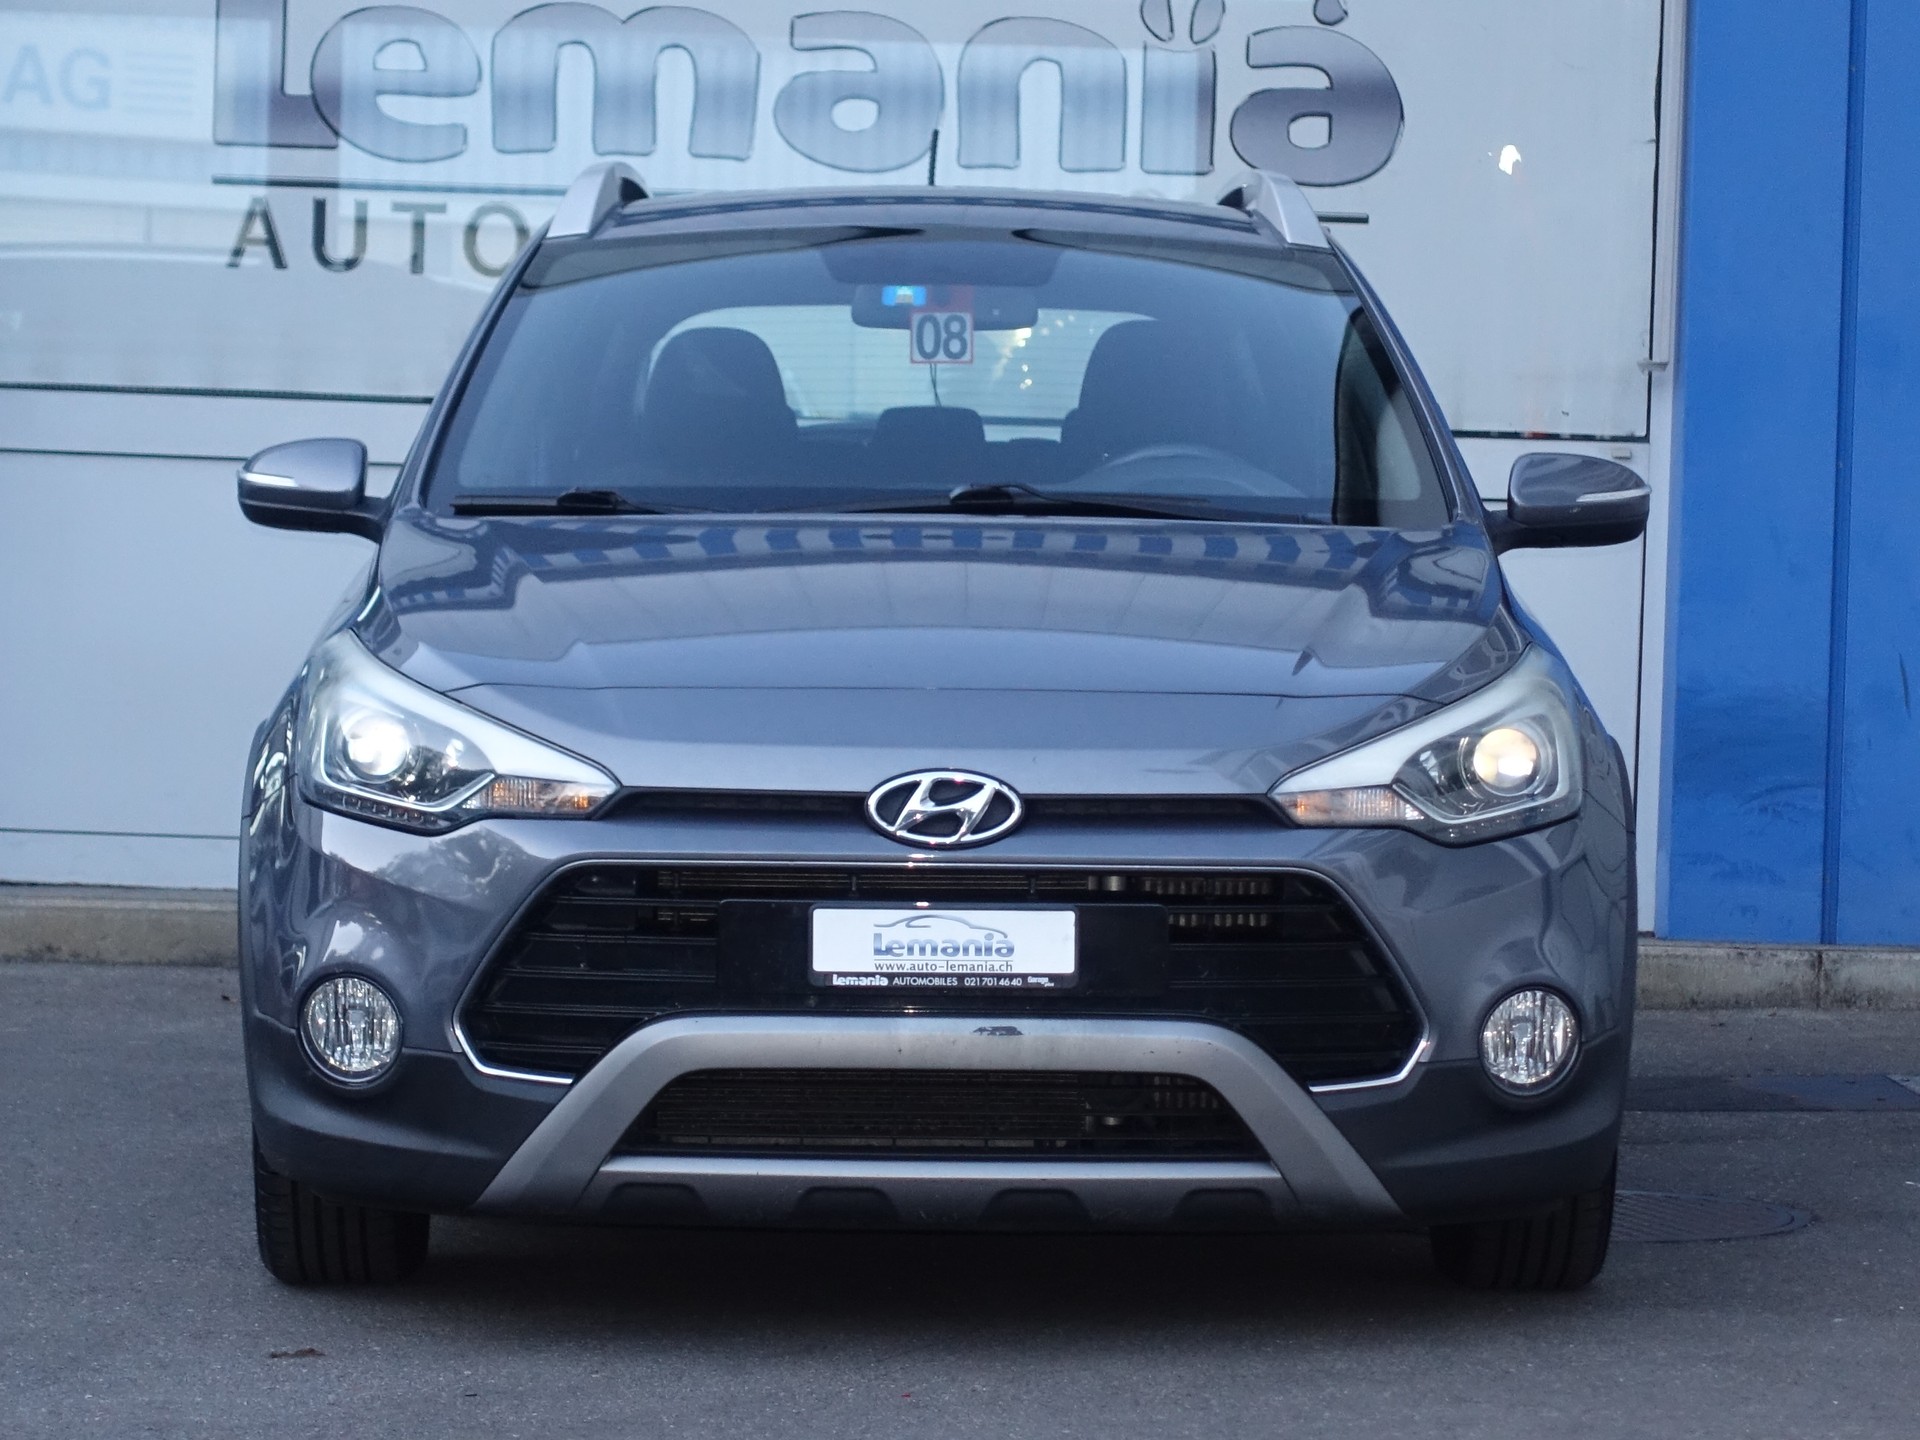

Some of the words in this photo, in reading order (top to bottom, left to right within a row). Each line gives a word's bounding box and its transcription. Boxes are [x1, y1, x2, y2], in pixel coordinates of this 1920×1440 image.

[916, 314, 968, 360] 08
[873, 932, 1015, 958] Lemania
[874, 960, 1013, 972] www.auto-lemania.ch
[832, 974, 889, 986] Lemania
[892, 976, 958, 986] AUTOMOBILES
